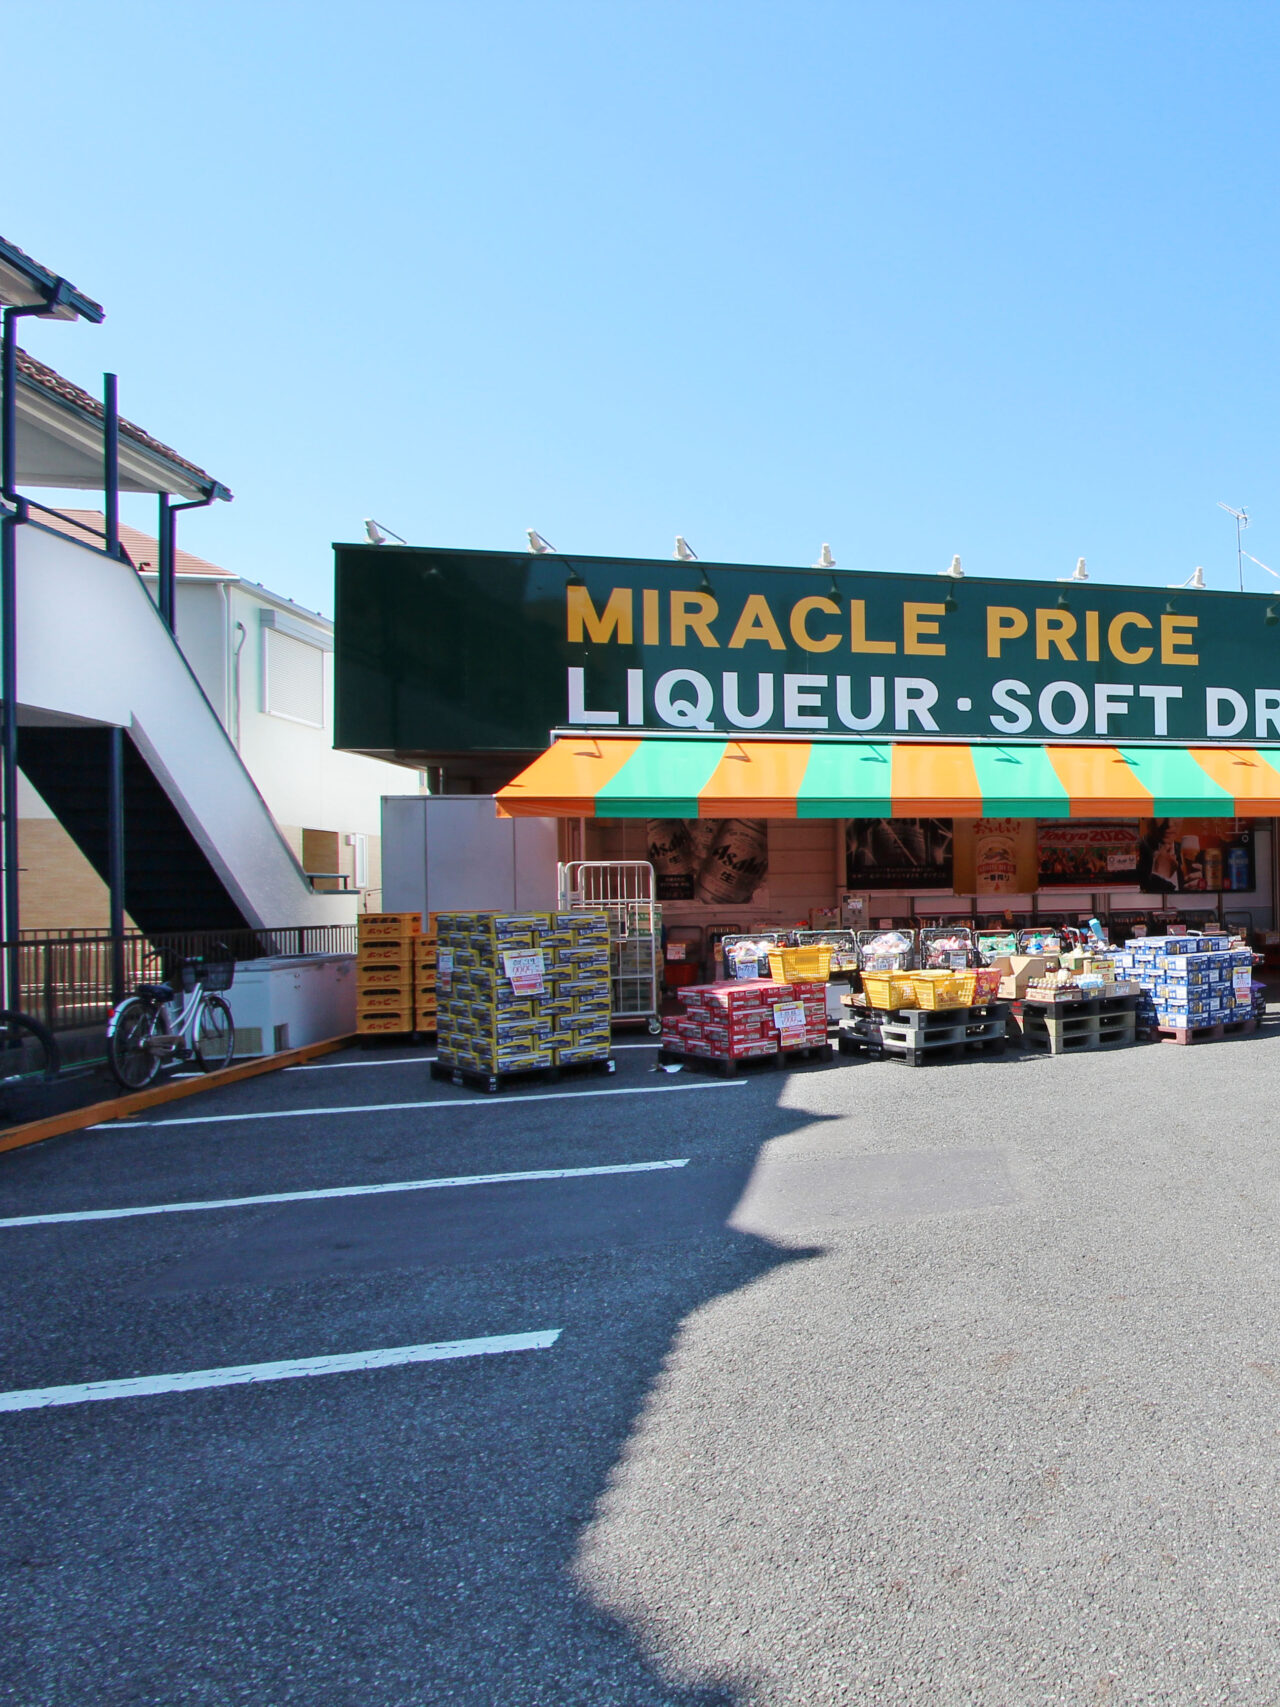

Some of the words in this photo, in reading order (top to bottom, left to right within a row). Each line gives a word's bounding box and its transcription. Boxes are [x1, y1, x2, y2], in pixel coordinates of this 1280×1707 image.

[567, 586, 947, 656] MIRACLE
[987, 606, 1199, 666] PRICE
[1040, 830, 1089, 843] Tokyo
[1089, 830, 1137, 842] 2020
[720, 871, 737, 885] 生
